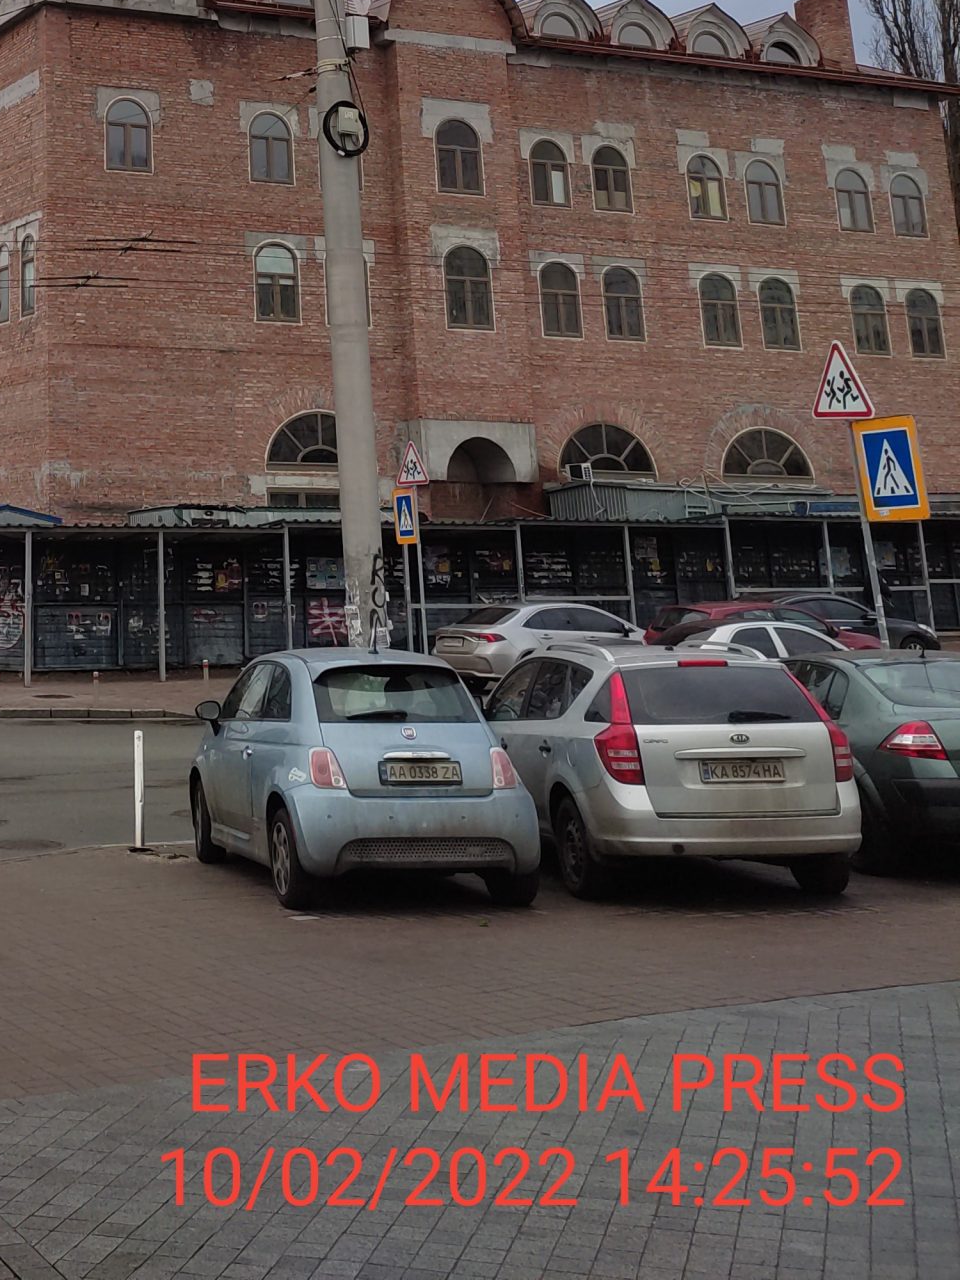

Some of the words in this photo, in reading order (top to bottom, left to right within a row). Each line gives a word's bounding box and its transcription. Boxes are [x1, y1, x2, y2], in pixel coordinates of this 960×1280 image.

[389, 765, 407, 779] AA
[409, 765, 439, 779] 0338
[441, 766, 460, 779] ZA
[710, 765, 730, 779] KA
[732, 764, 761, 779] 8574
[763, 764, 783, 778] HA
